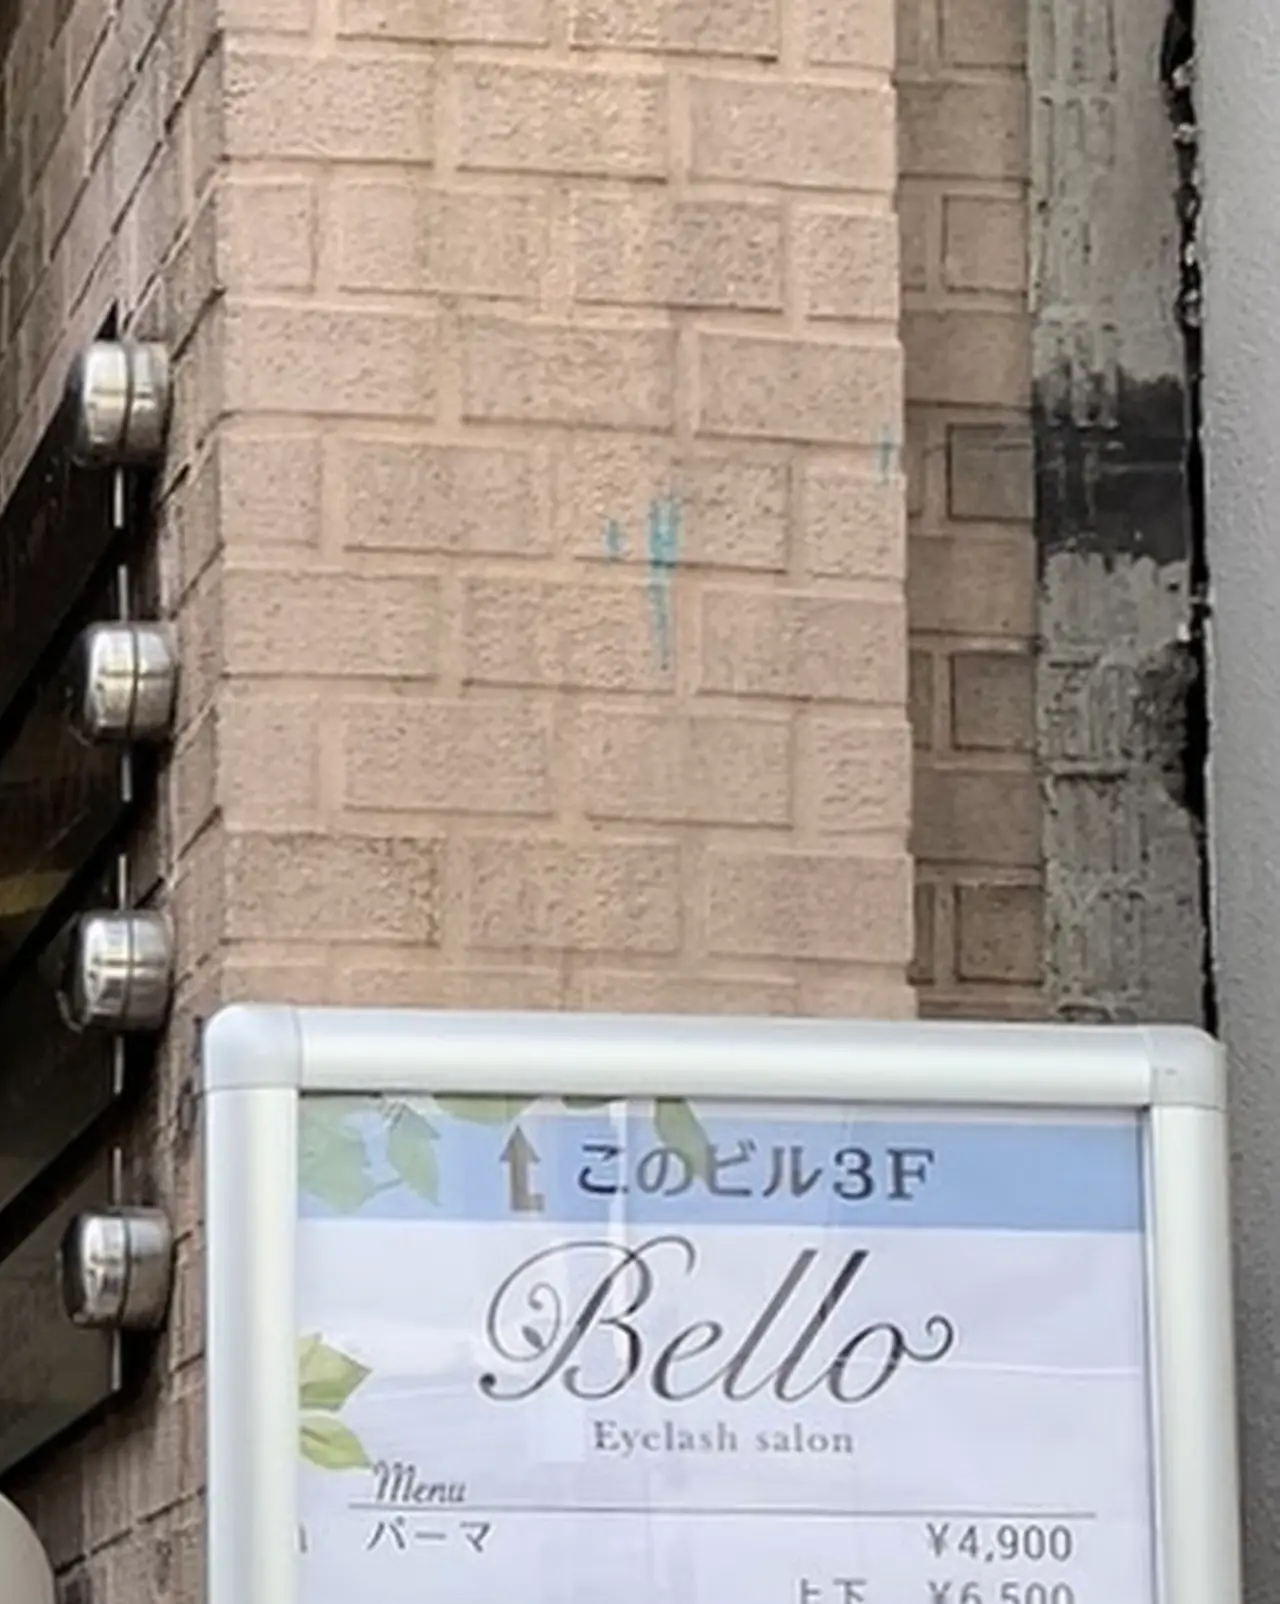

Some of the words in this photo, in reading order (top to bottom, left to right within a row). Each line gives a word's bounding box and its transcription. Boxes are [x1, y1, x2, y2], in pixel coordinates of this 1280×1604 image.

[578, 1138, 935, 1201] このビル3F
[479, 1236, 954, 1403] Bello
[756, 1423, 854, 1454] salon
[372, 1460, 466, 1502] Menu
[367, 1515, 492, 1553] パーマ
[927, 1523, 1073, 1562] ¥4,900
